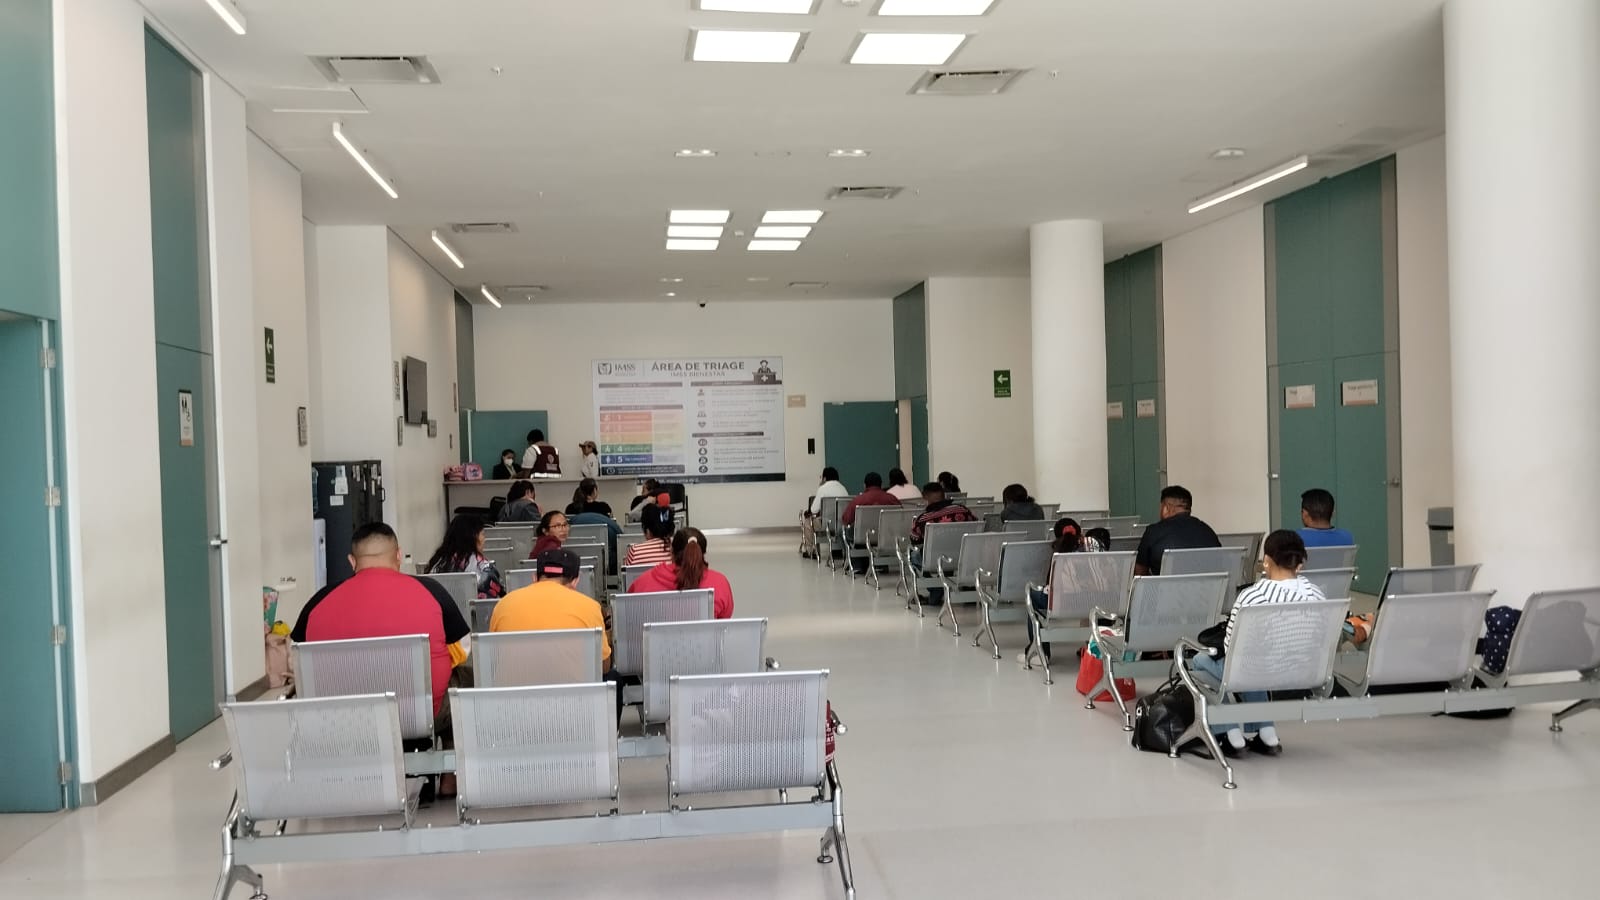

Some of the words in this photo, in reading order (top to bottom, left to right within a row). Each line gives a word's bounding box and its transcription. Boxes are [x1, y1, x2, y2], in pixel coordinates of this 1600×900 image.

[651, 361, 682, 372] ÁREA
[685, 362, 700, 371] DE
[703, 361, 745, 370] TRIAGE
